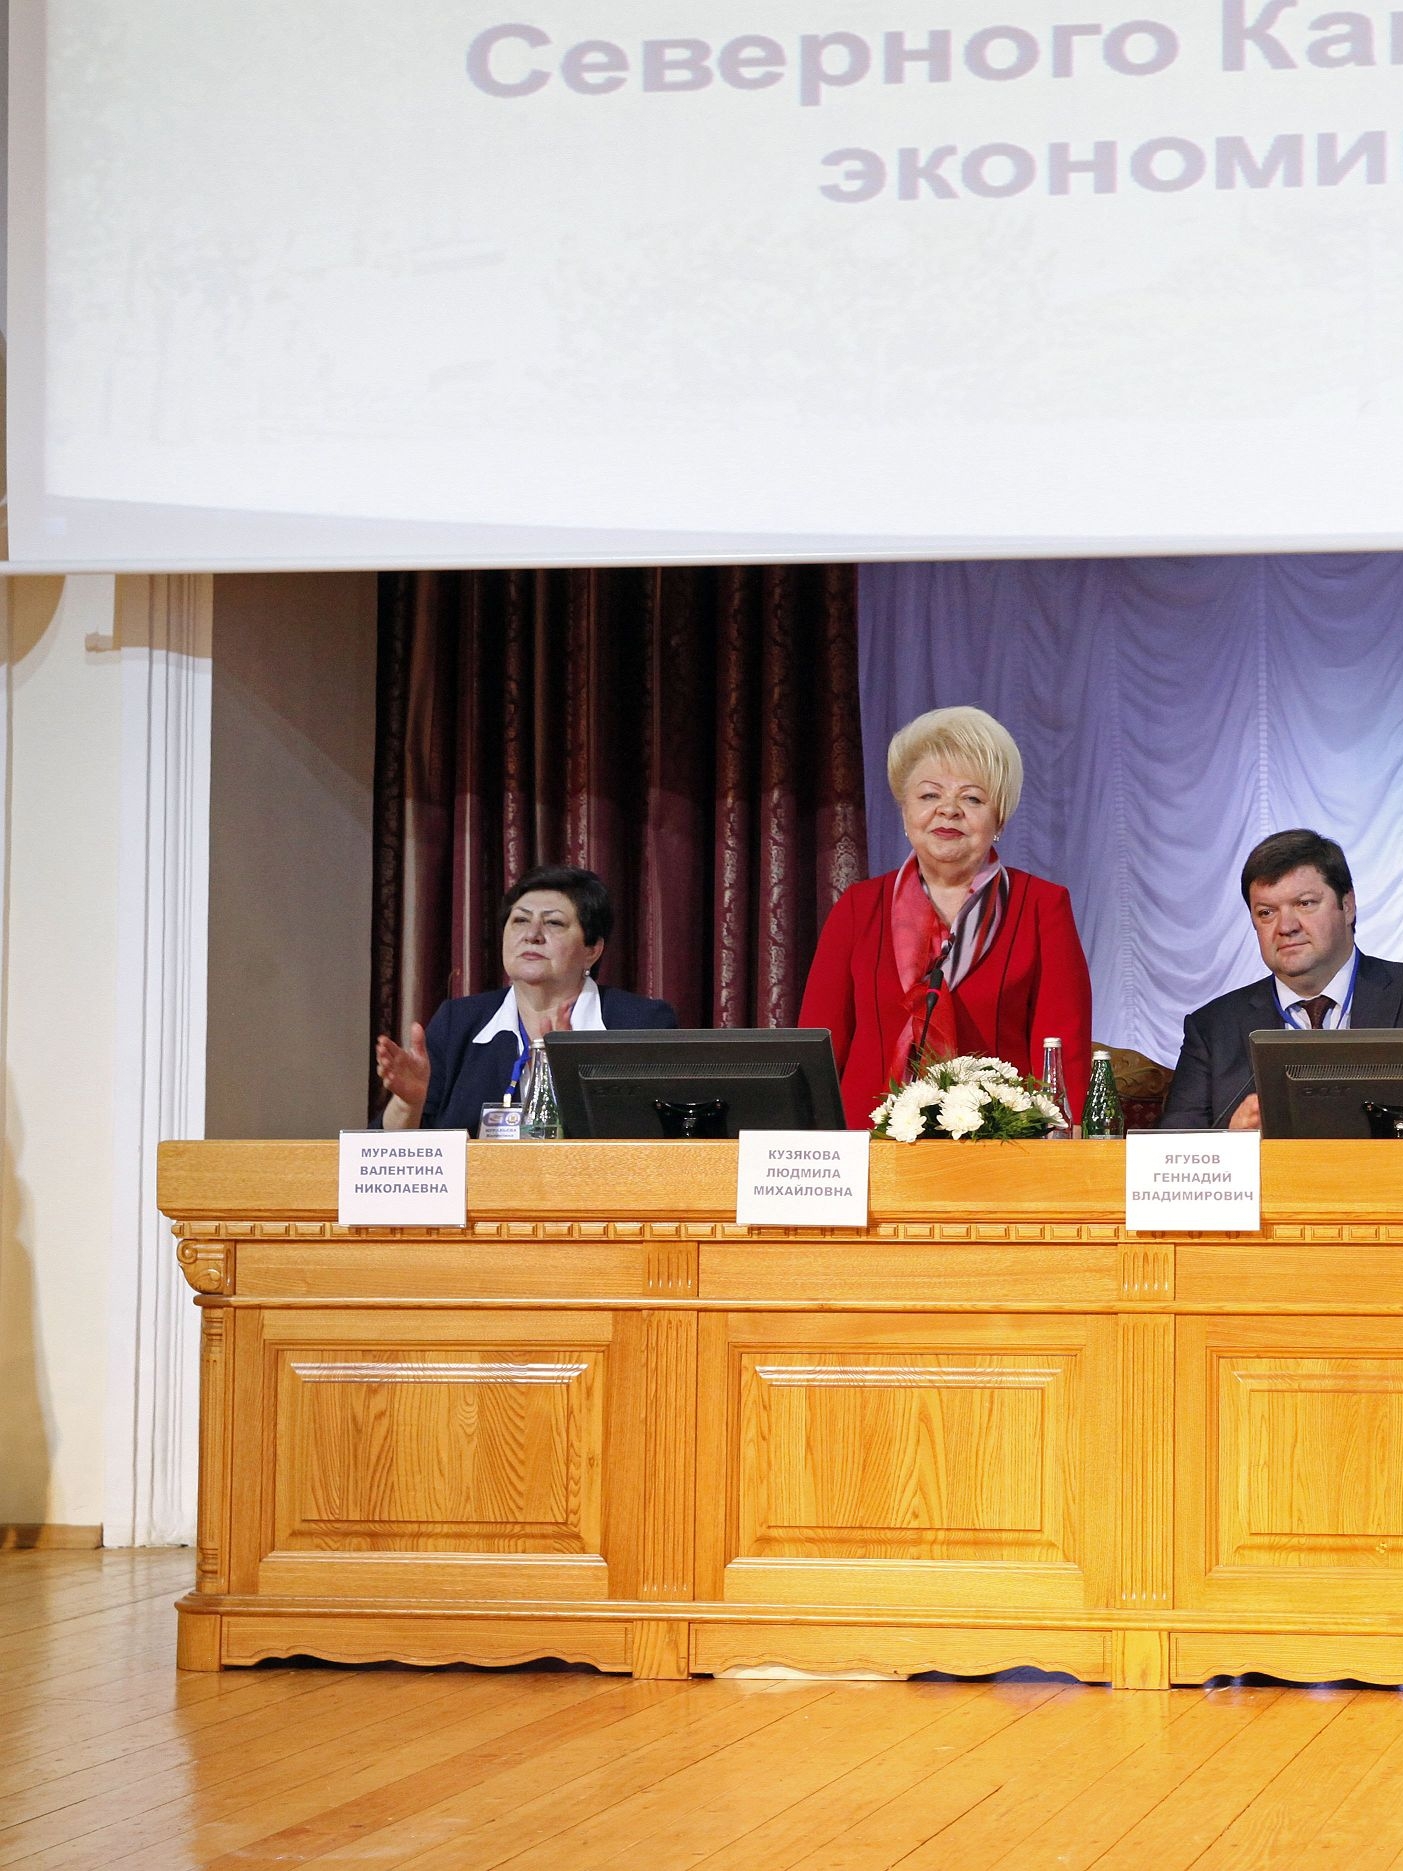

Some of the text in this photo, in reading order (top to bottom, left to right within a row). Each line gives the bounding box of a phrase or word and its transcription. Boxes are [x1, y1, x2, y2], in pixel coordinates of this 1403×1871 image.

[465, 19, 1181, 108] Северного
[361, 1147, 443, 1158] МУРАВЬЕВА
[768, 1149, 841, 1161] КУЗЯКОВА
[1164, 1153, 1221, 1165] ЯГУБОВ
[360, 1165, 444, 1176] ВАЛЕНТИНА
[766, 1167, 841, 1180] ЛЮДМИЛА
[1153, 1170, 1232, 1185] ГЕННАДИЙ
[354, 1183, 449, 1194] НИКОЛАЕВНА
[753, 1183, 853, 1197] МИХАЙЛОВНА
[1132, 1190, 1254, 1203] ВЛАДИМИРОВИЧ
